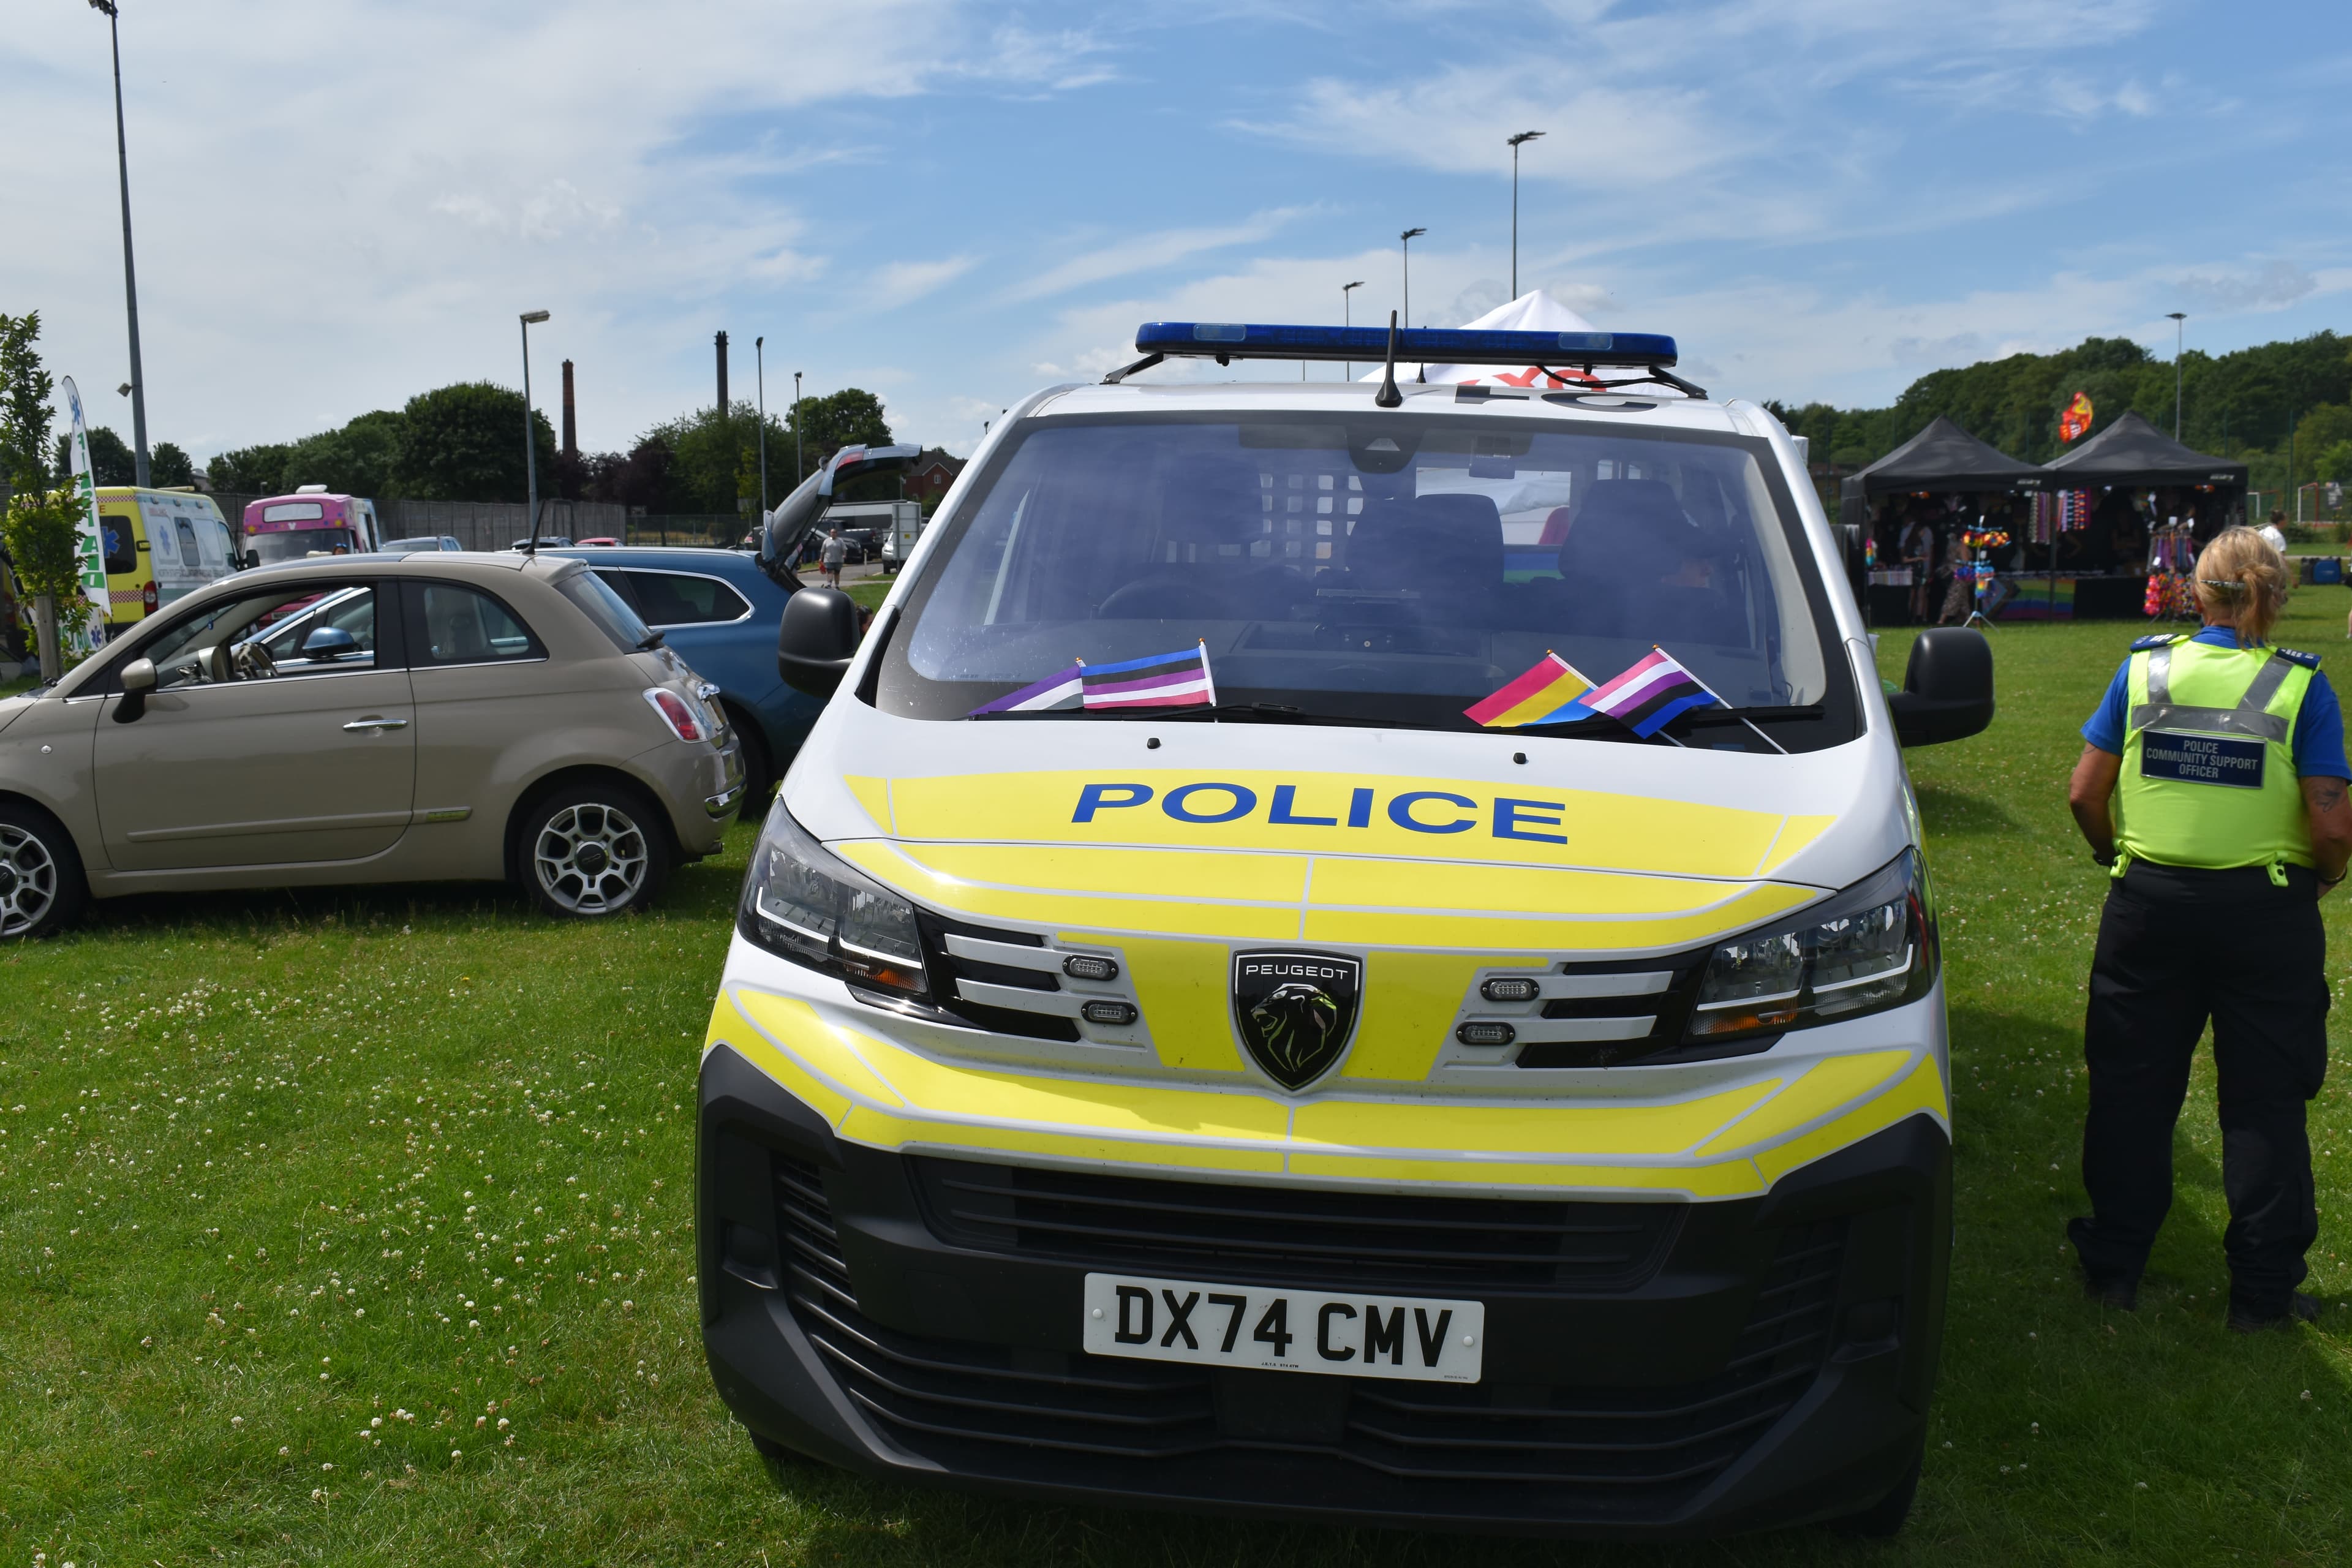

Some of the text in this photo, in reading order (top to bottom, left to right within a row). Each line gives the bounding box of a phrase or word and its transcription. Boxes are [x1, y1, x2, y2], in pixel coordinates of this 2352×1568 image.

[2183, 740, 2218, 754] POLICE
[2146, 748, 2258, 770] COMMUNITY SUPPORT
[2179, 764, 2218, 778] OFFICER
[1071, 783, 1567, 845] POLICE
[1246, 964, 1348, 980] PEUGEOT
[1115, 1285, 1452, 1367] DX74 CMV
